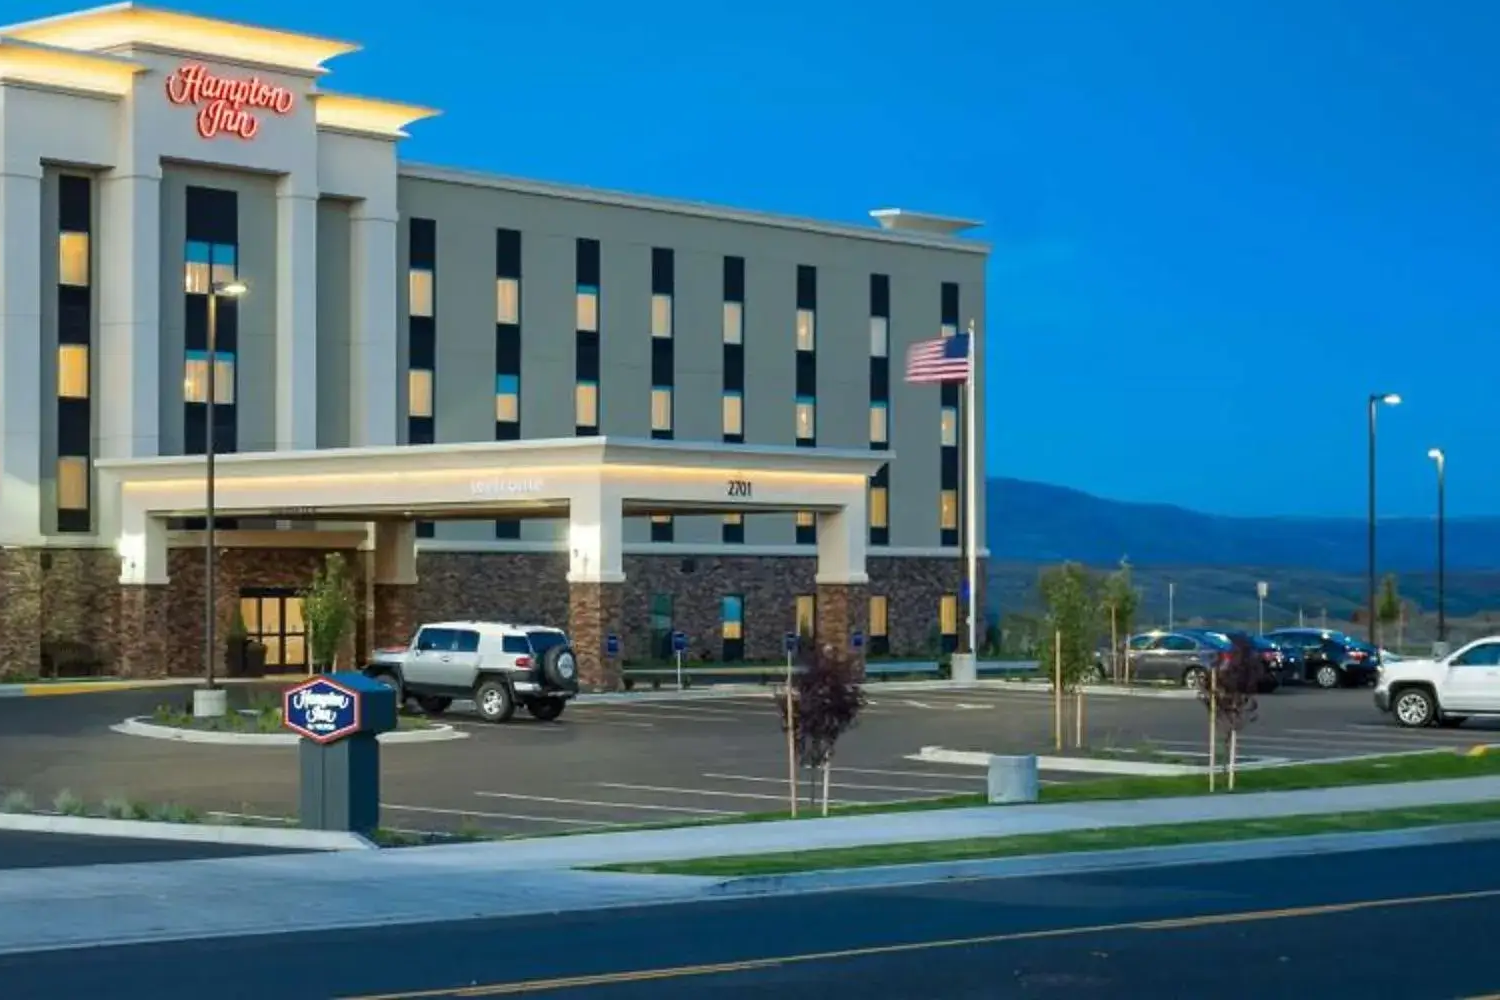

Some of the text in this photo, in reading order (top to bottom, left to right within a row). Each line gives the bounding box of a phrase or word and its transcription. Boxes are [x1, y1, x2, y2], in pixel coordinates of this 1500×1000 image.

[167, 63, 293, 113] Hampton
[198, 100, 257, 138] Inn
[728, 480, 751, 496] 2701
